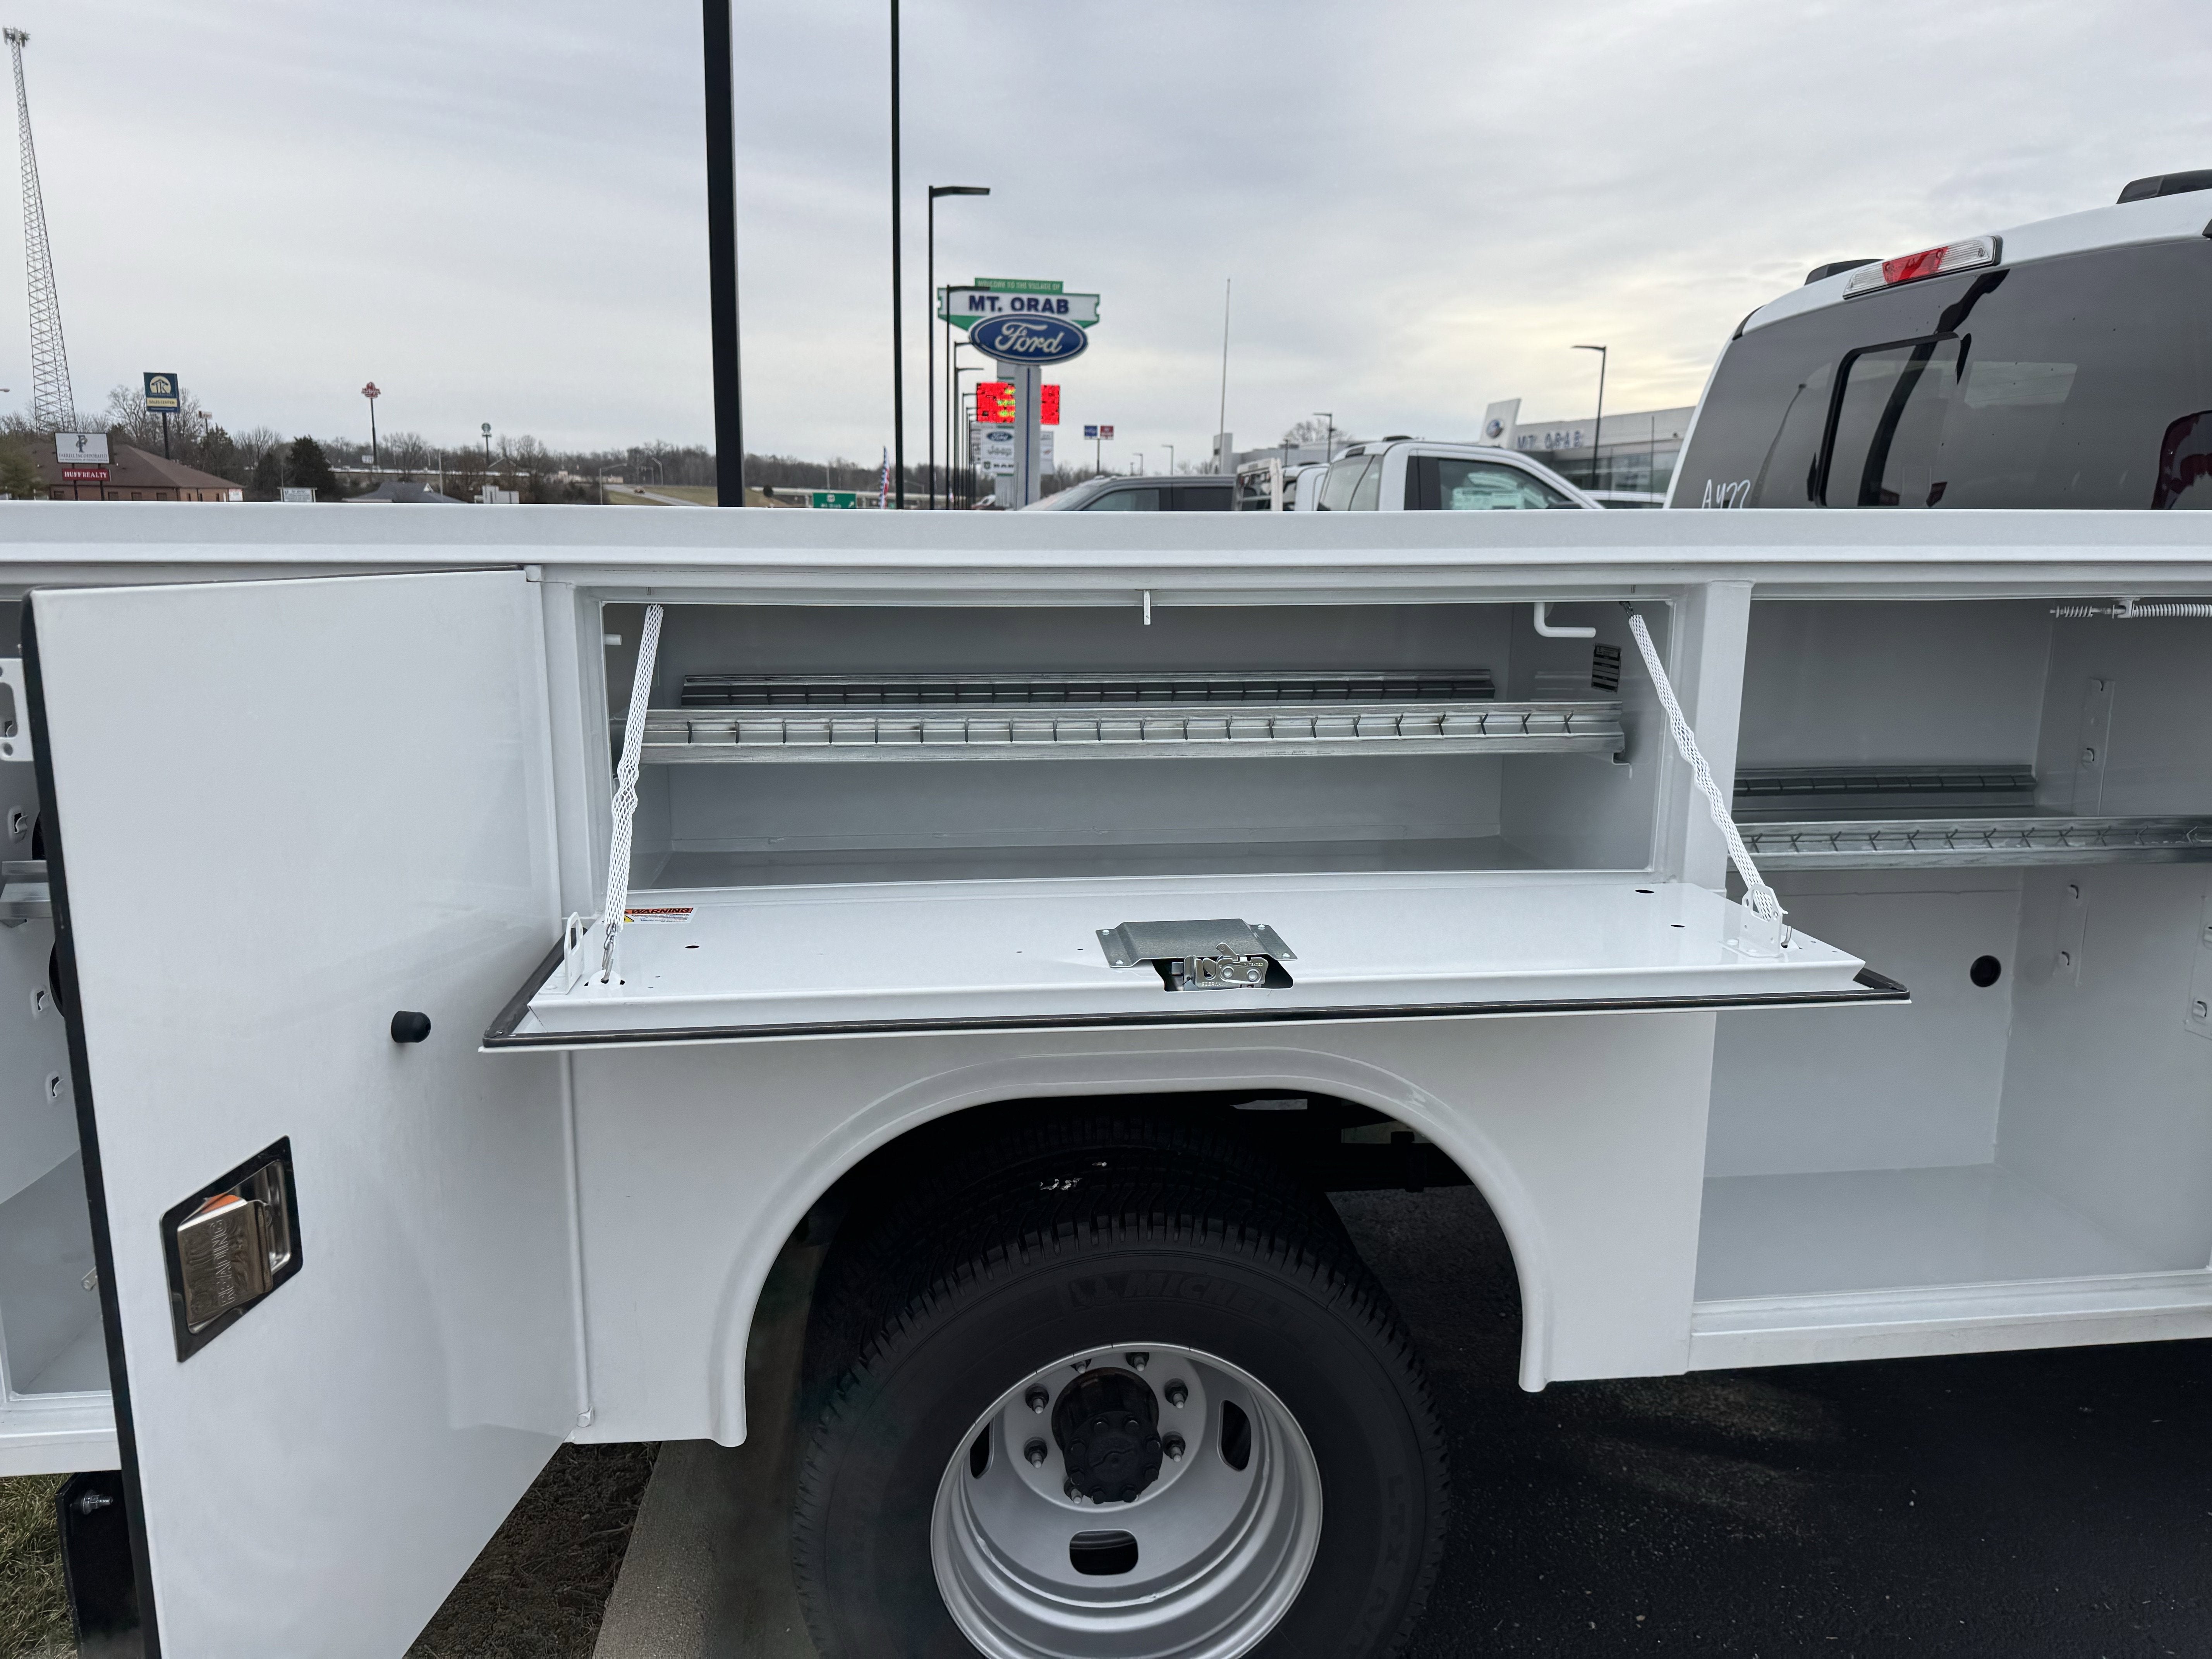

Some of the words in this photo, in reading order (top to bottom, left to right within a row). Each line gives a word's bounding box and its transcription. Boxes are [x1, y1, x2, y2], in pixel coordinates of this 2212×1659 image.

[969, 295, 1003, 312] MT.
[1011, 297, 1069, 314] ORAB
[994, 321, 1065, 354] Ford
[210, 1219, 236, 1307] READING
